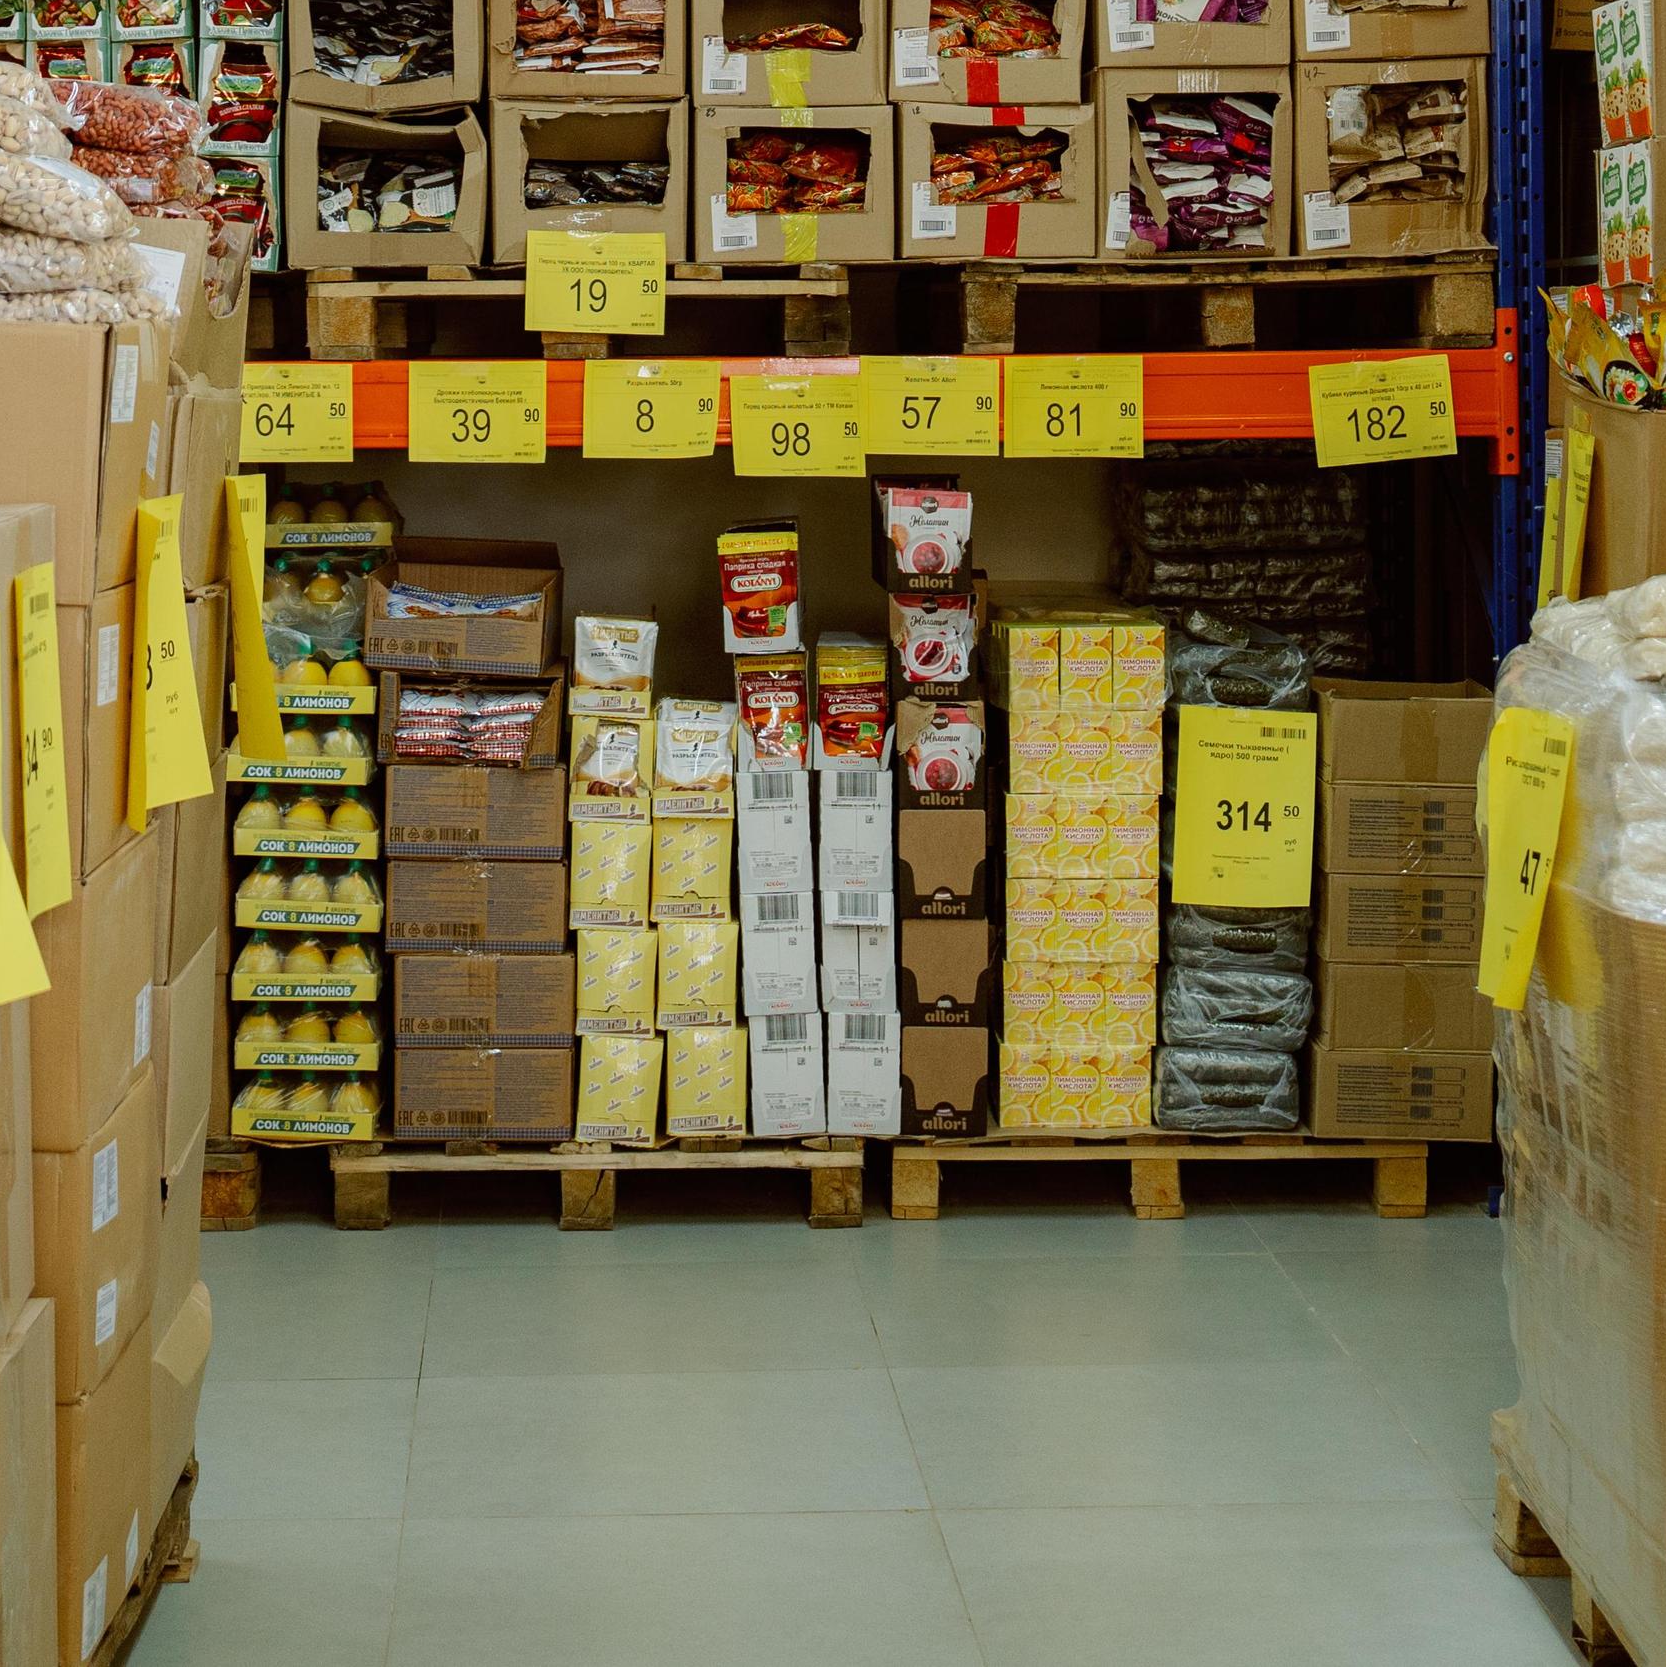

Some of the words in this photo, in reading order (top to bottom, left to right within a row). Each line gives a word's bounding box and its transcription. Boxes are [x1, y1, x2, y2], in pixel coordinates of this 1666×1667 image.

[570, 278, 607, 313] 19
[642, 279, 658, 293] 50
[255, 403, 295, 436] 64
[329, 402, 346, 417] 50
[636, 399, 655, 433] 8
[698, 398, 713, 412] 90
[901, 396, 942, 430] 57
[976, 396, 993, 411] 90
[1046, 402, 1081, 437] 81
[1120, 402, 1137, 417] 90
[451, 408, 491, 443] 39
[524, 408, 540, 422] 90
[1347, 405, 1407, 442] 182
[1429, 400, 1446, 415] 50
[771, 422, 811, 456] 98
[844, 421, 858, 436] 50
[286, 533, 308, 543] СОК
[320, 532, 372, 543] ЛИМОНОВ
[908, 575, 953, 589] allori
[160, 639, 175, 659] 50
[914, 682, 958, 696] allori
[293, 696, 350, 709] ЛИМОНОВ
[1198, 740, 1234, 749] Семечки
[1236, 743, 1284, 752] тыквенные
[1210, 751, 1234, 760] ядро)
[1236, 752, 1250, 761] 500
[1252, 754, 1279, 762] грамм
[247, 767, 271, 777] СОК
[285, 767, 341, 779] ЛИМОНОВ
[919, 792, 965, 806] allori
[1216, 799, 1272, 832] 314
[1283, 805, 1300, 818] 50
[260, 841, 285, 851] СОК
[297, 842, 354, 854] ЛИМОНОВ
[1520, 848, 1541, 896] 47
[922, 902, 965, 915] allori
[262, 911, 286, 922] СОК
[300, 912, 356, 925] ЛИМОНОВ
[257, 985, 281, 996] СОК
[294, 985, 351, 996] ЛИМОНОВ
[925, 1010, 969, 1023] allori
[260, 1054, 285, 1064] СОК
[297, 1054, 354, 1065] ЛИМОНОВ
[255, 1120, 280, 1130] СОК
[293, 1121, 350, 1134] ЛИМОНОВ
[922, 1117, 966, 1130] allori
